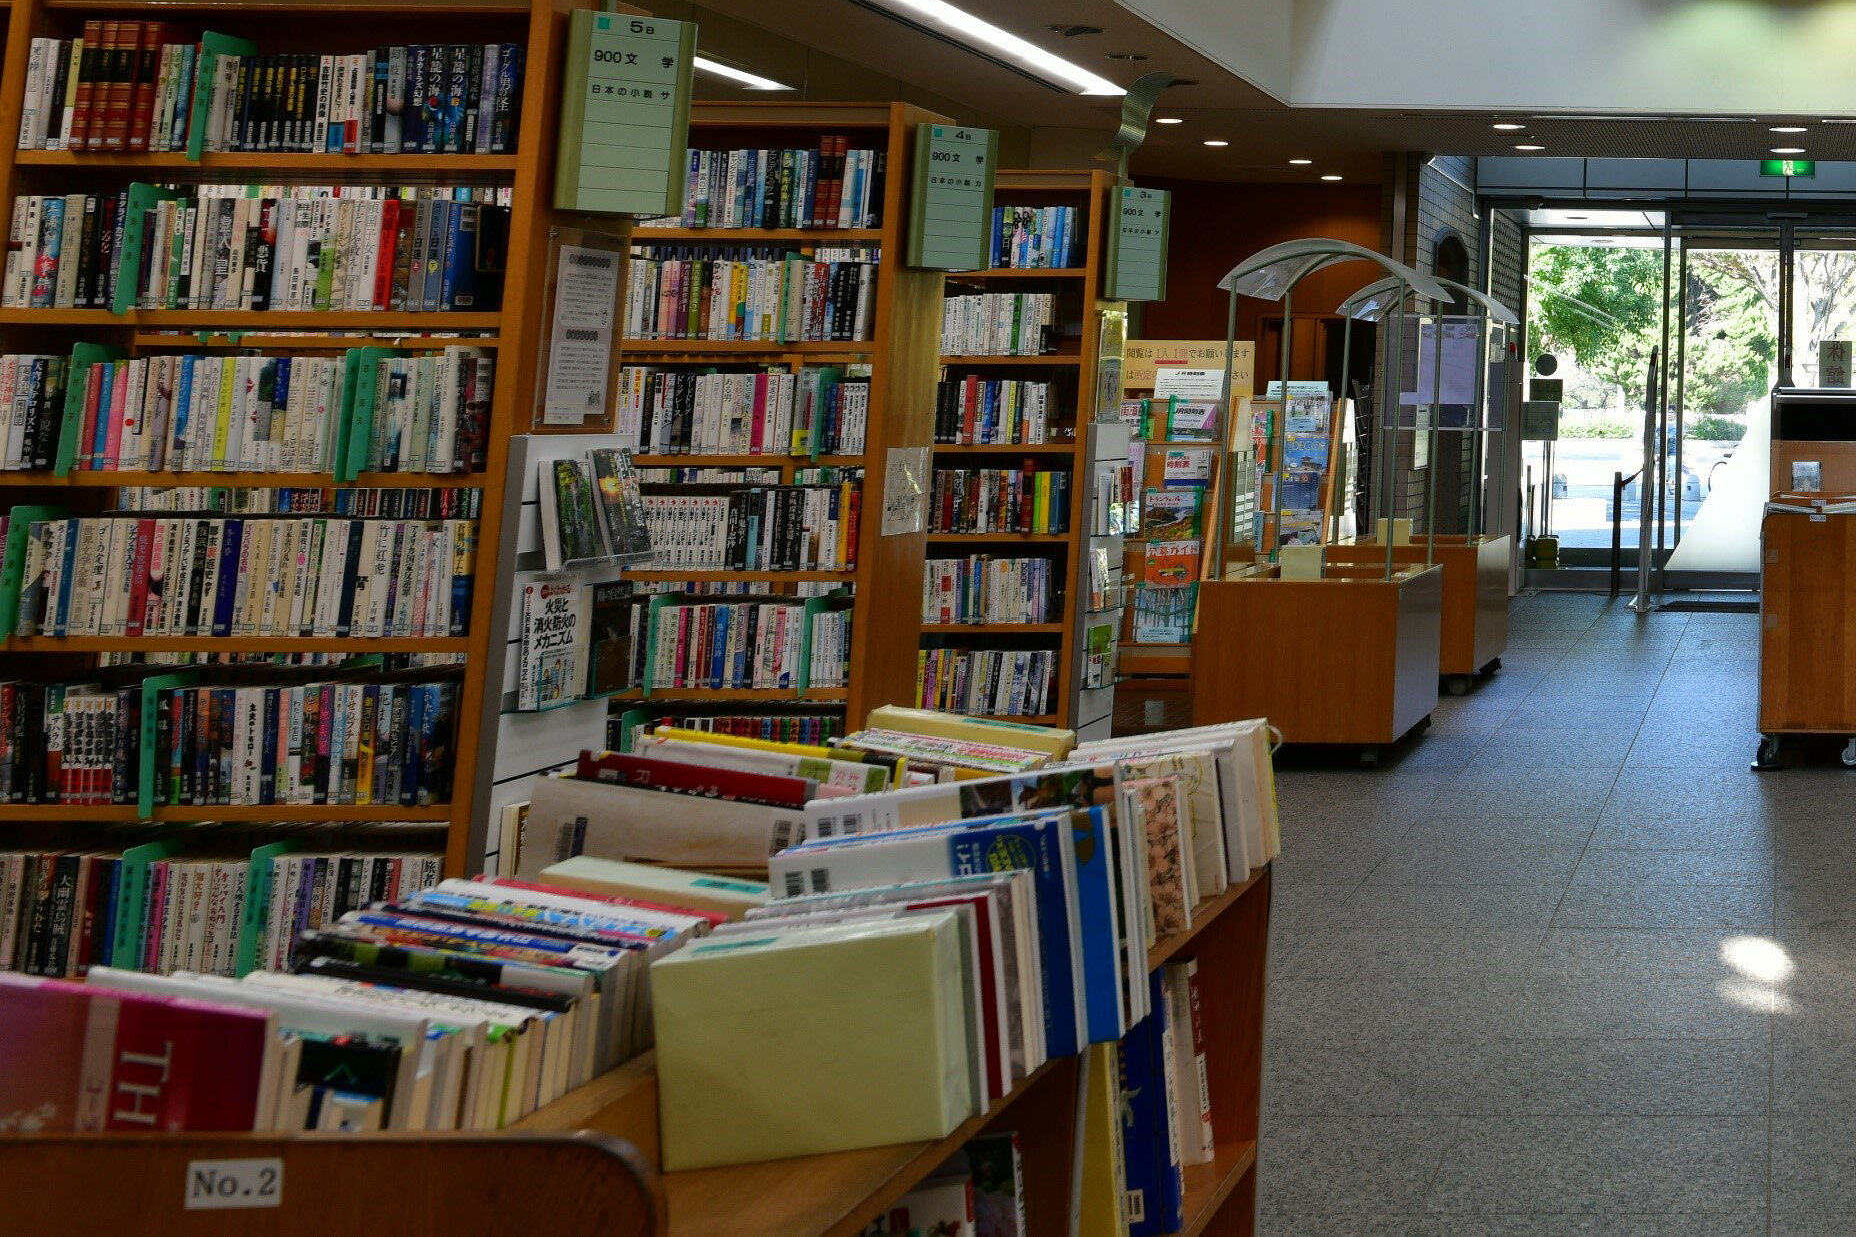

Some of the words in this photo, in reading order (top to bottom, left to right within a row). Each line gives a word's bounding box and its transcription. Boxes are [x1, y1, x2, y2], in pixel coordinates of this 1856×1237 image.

[630, 20, 655, 35] 5B
[594, 49, 622, 64] 900
[932, 151, 951, 163] 900
[1122, 206, 1136, 216] 900
[1174, 407, 1206, 417] JR時刻表
[1148, 545, 1198, 556] 公募ガイド
[545, 597, 569, 615] 火災と
[534, 630, 574, 650] メカニズム
[193, 1166, 277, 1199] No.2
